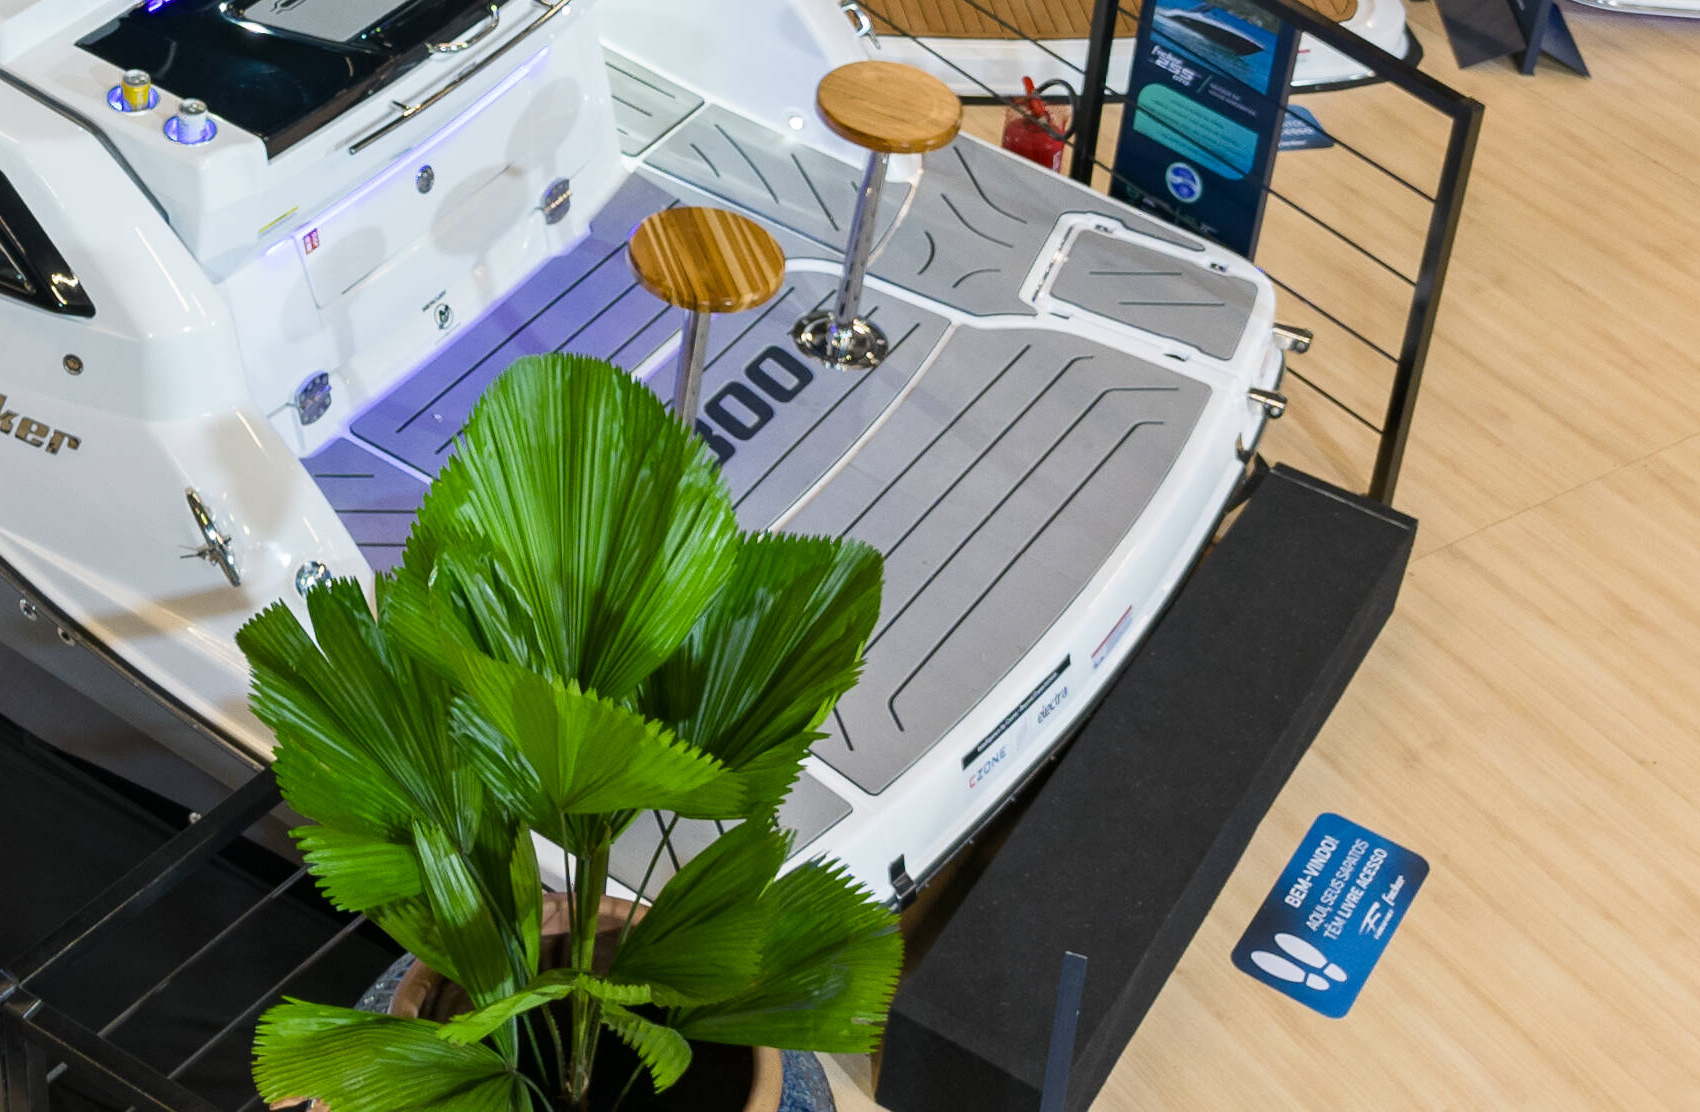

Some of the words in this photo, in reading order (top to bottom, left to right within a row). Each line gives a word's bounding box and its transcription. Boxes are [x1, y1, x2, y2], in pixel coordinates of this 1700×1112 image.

[1284, 835, 1340, 908] BEM-VINDO!
[1320, 878, 1345, 906] SEUS
[1335, 838, 1369, 882] SAPATOS
[1337, 886, 1364, 919] LIVRE
[1356, 848, 1388, 890] ACESSO
